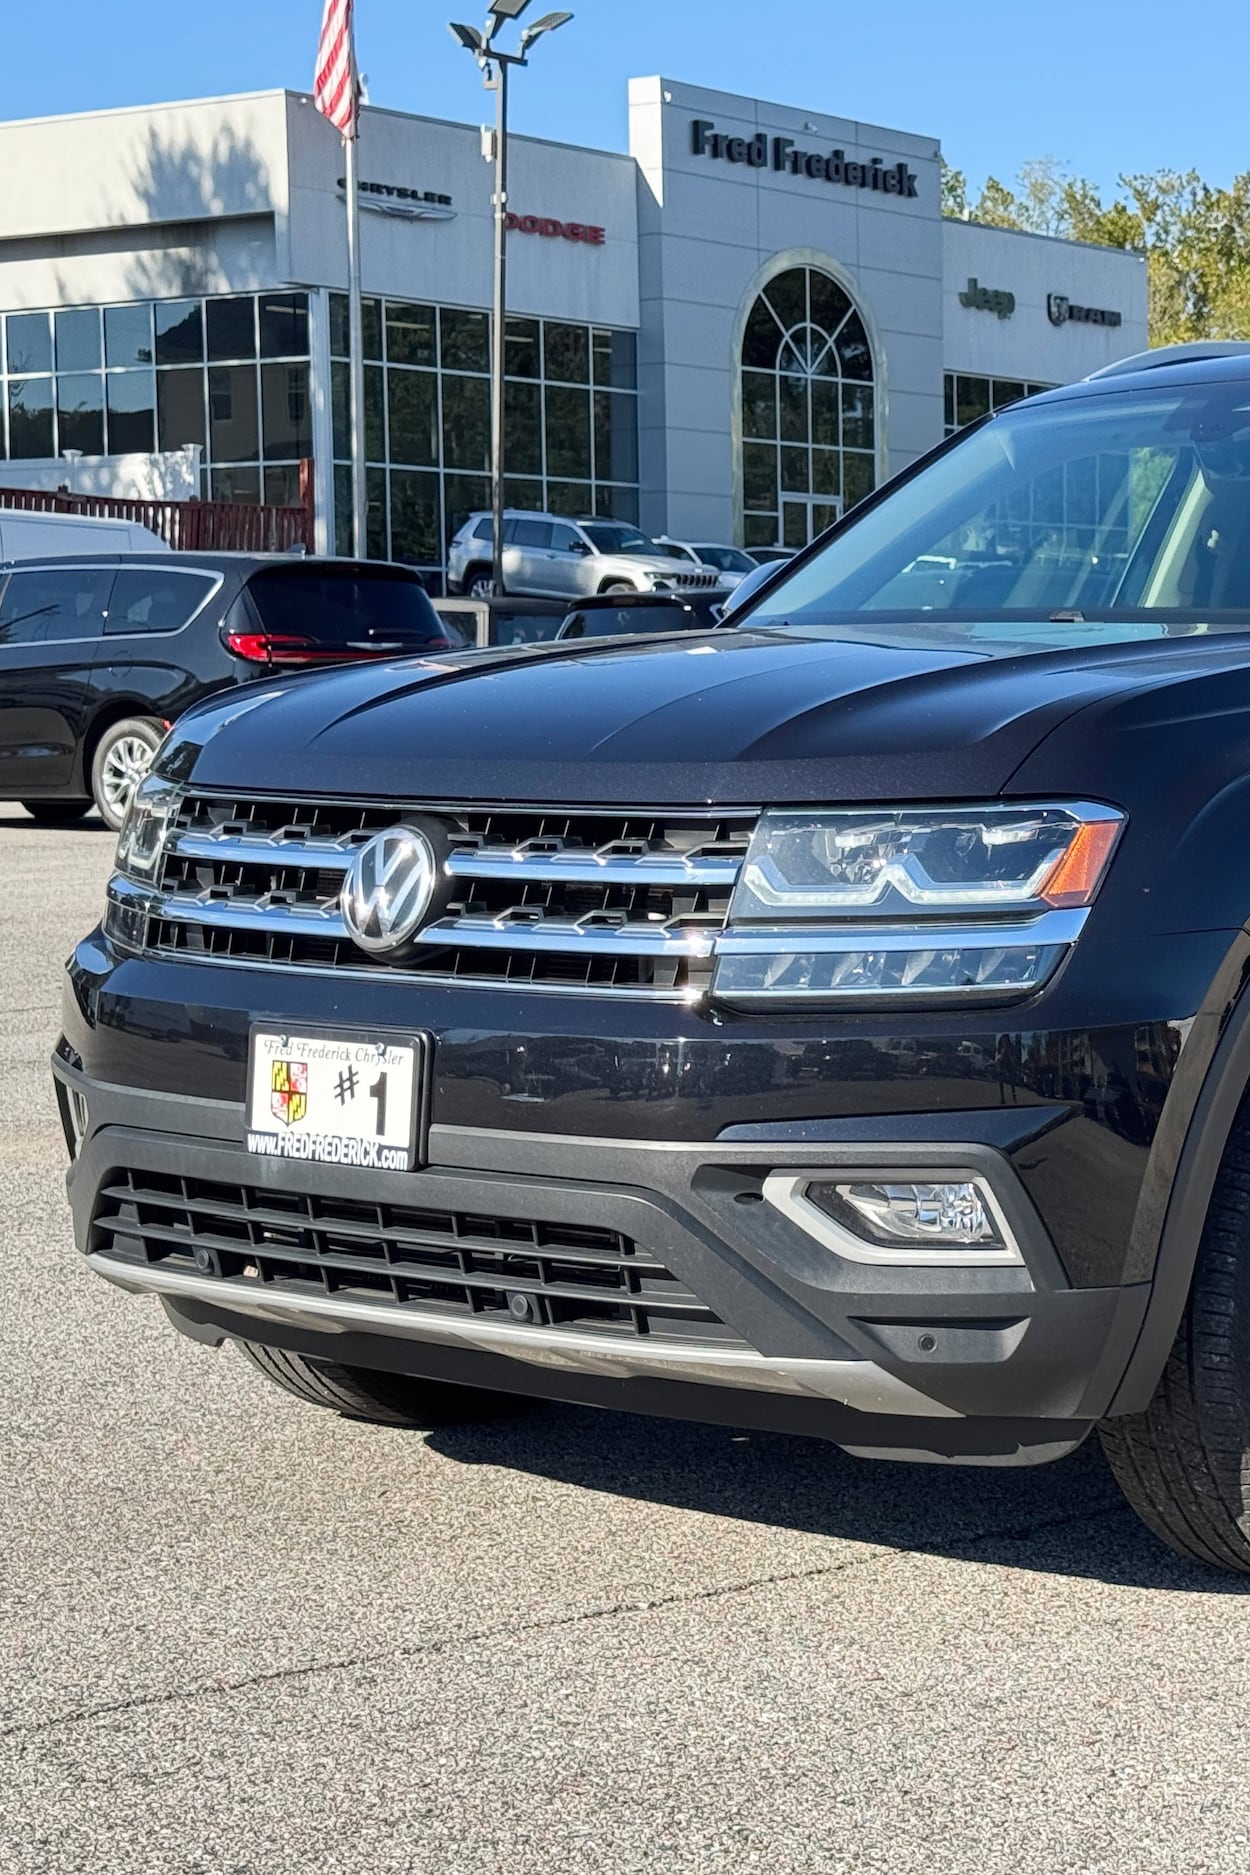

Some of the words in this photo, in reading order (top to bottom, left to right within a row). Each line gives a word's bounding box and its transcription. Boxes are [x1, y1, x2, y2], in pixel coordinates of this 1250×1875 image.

[691, 119, 767, 168] Fred
[773, 136, 918, 197] Frederick
[504, 212, 605, 245] DODGE
[958, 277, 1015, 320] Jeep
[1068, 304, 1122, 327] RAM
[264, 1039, 293, 1057] Fred
[296, 1042, 352, 1061] Frederick
[355, 1047, 404, 1067] Chrysler
[247, 1130, 409, 1171] www.FREDFREDERICK.com
